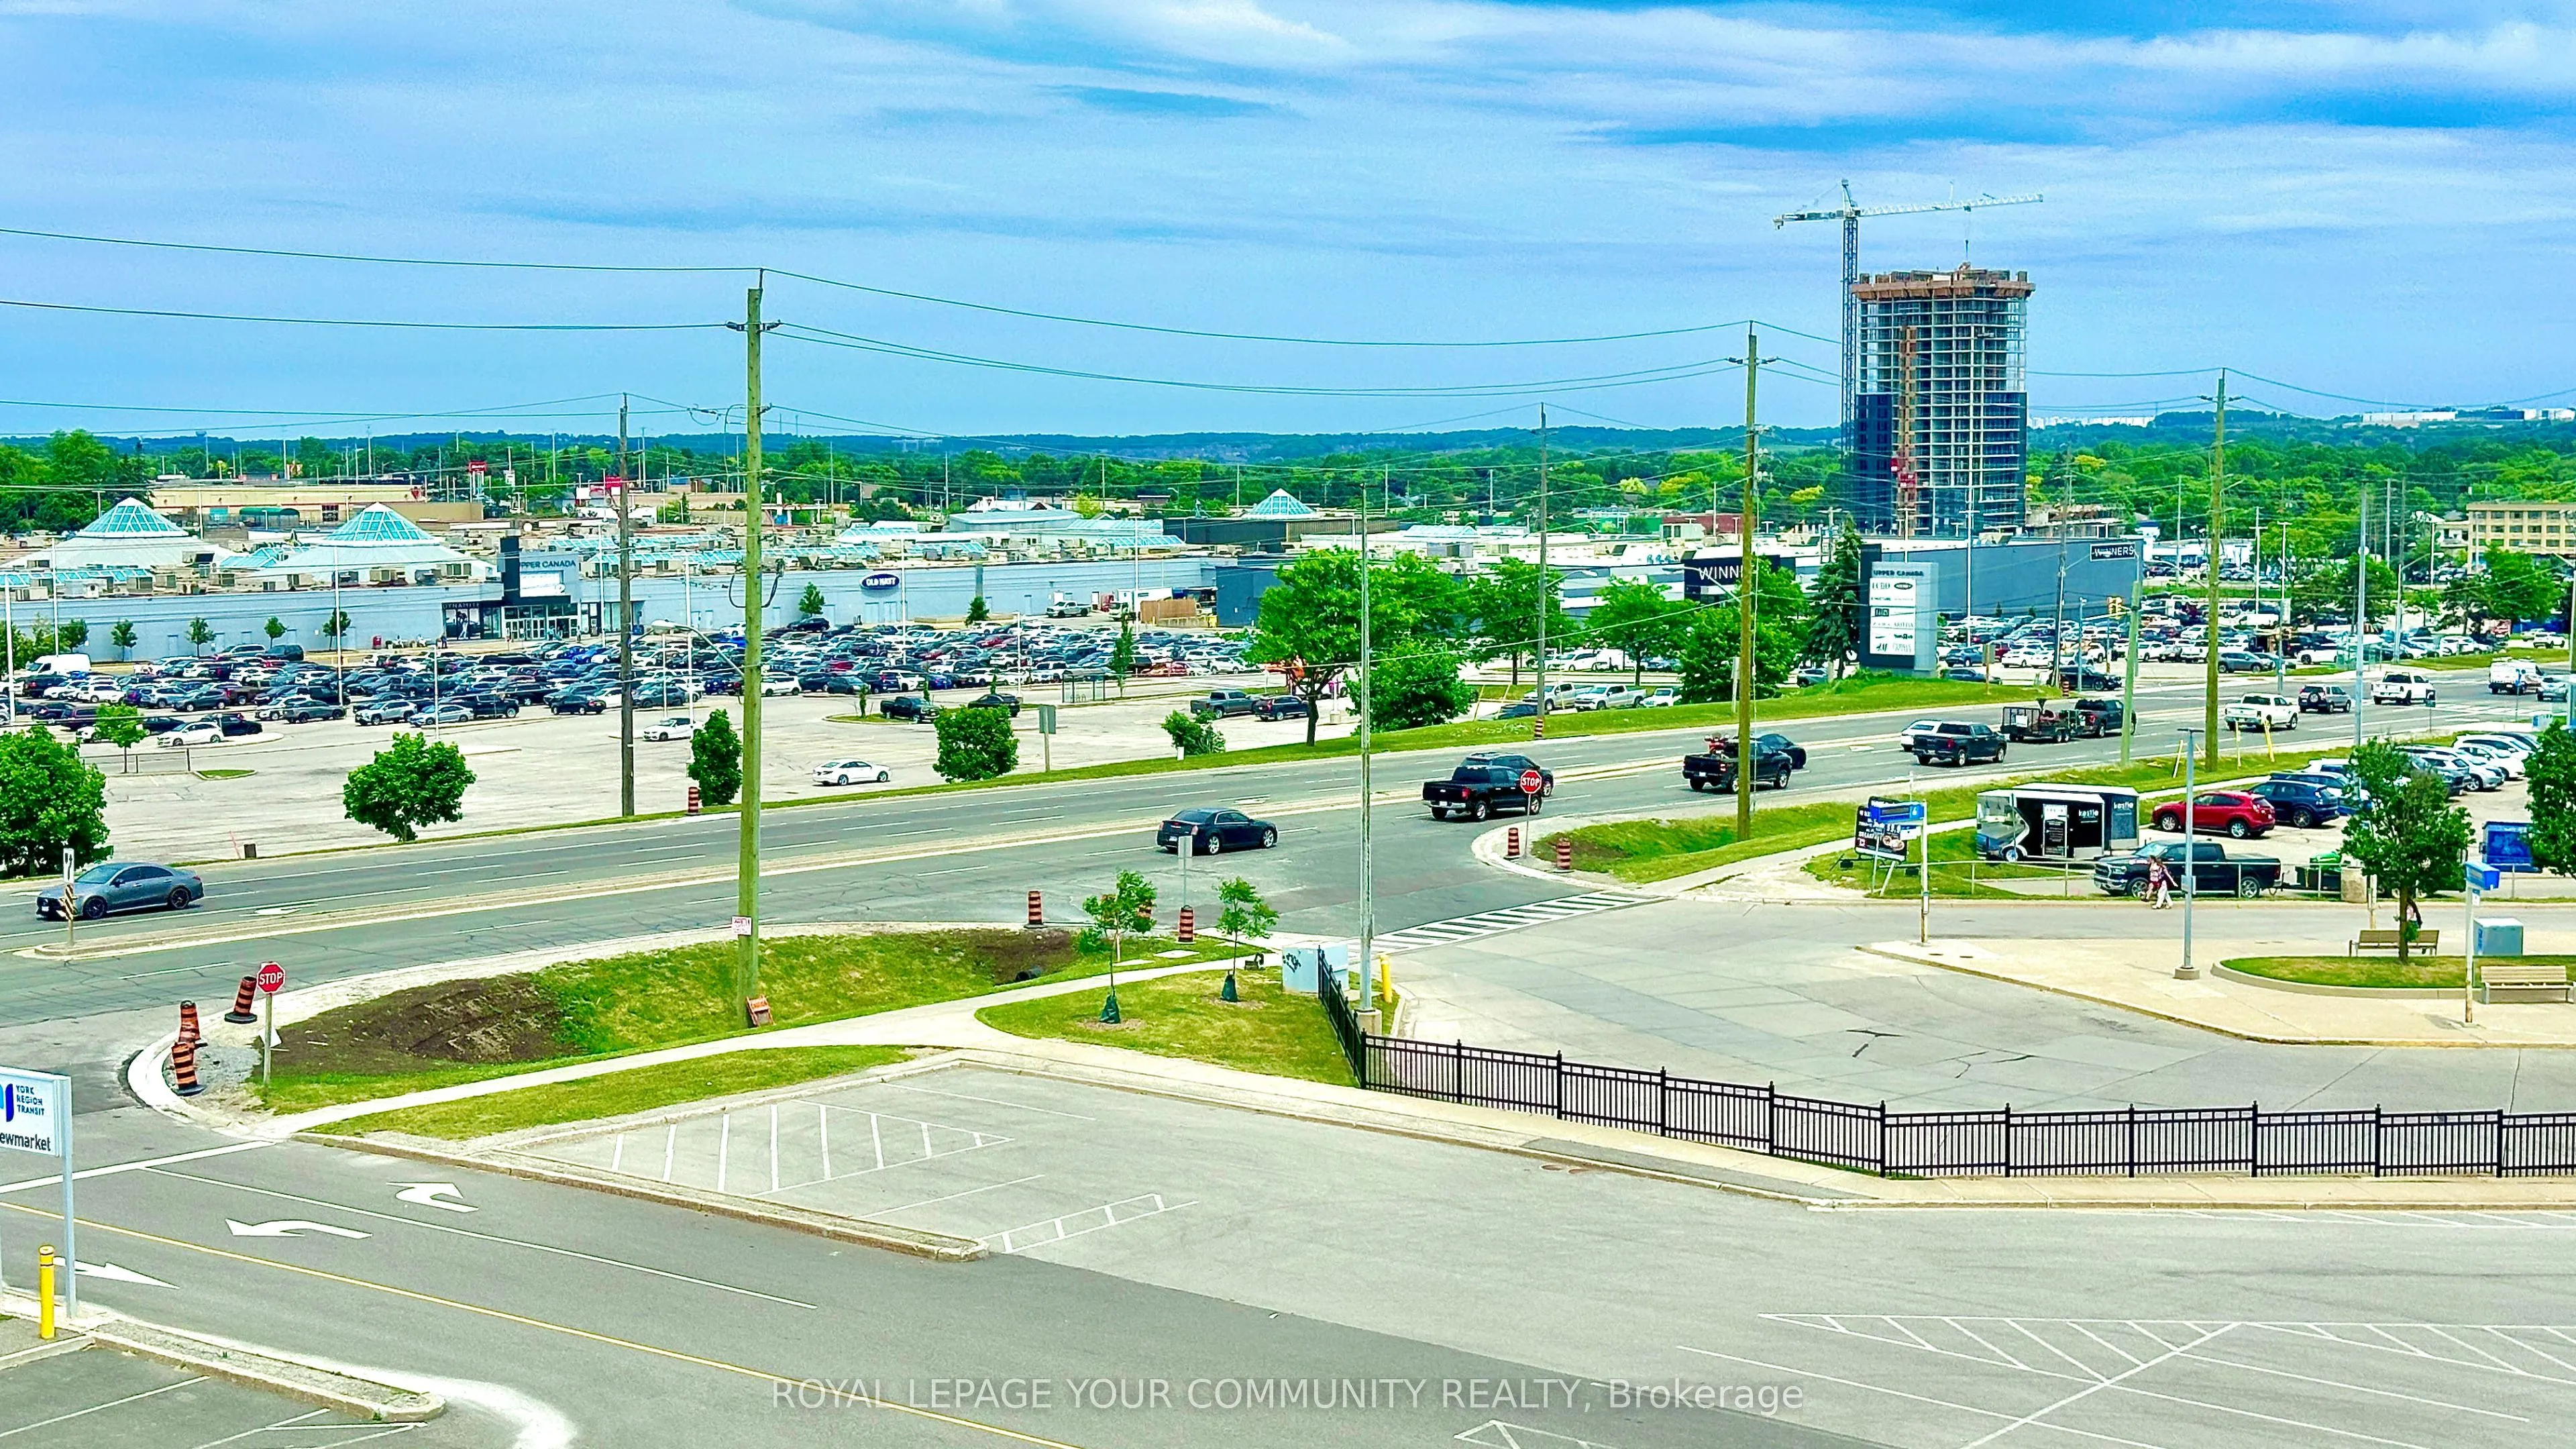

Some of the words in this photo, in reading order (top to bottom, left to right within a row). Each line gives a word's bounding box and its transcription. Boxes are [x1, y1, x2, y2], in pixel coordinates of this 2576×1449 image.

[542, 559, 576, 568] CANADA
[1699, 565, 1743, 580] WINN
[866, 578, 879, 586] OLD
[1521, 777, 1540, 788] STOP
[259, 971, 283, 985] STOP
[16, 1085, 34, 1094] YORK
[17, 1095, 43, 1106] REGION
[17, 1105, 44, 1116] TRANSIT
[0, 1132, 51, 1152] ewmarket
